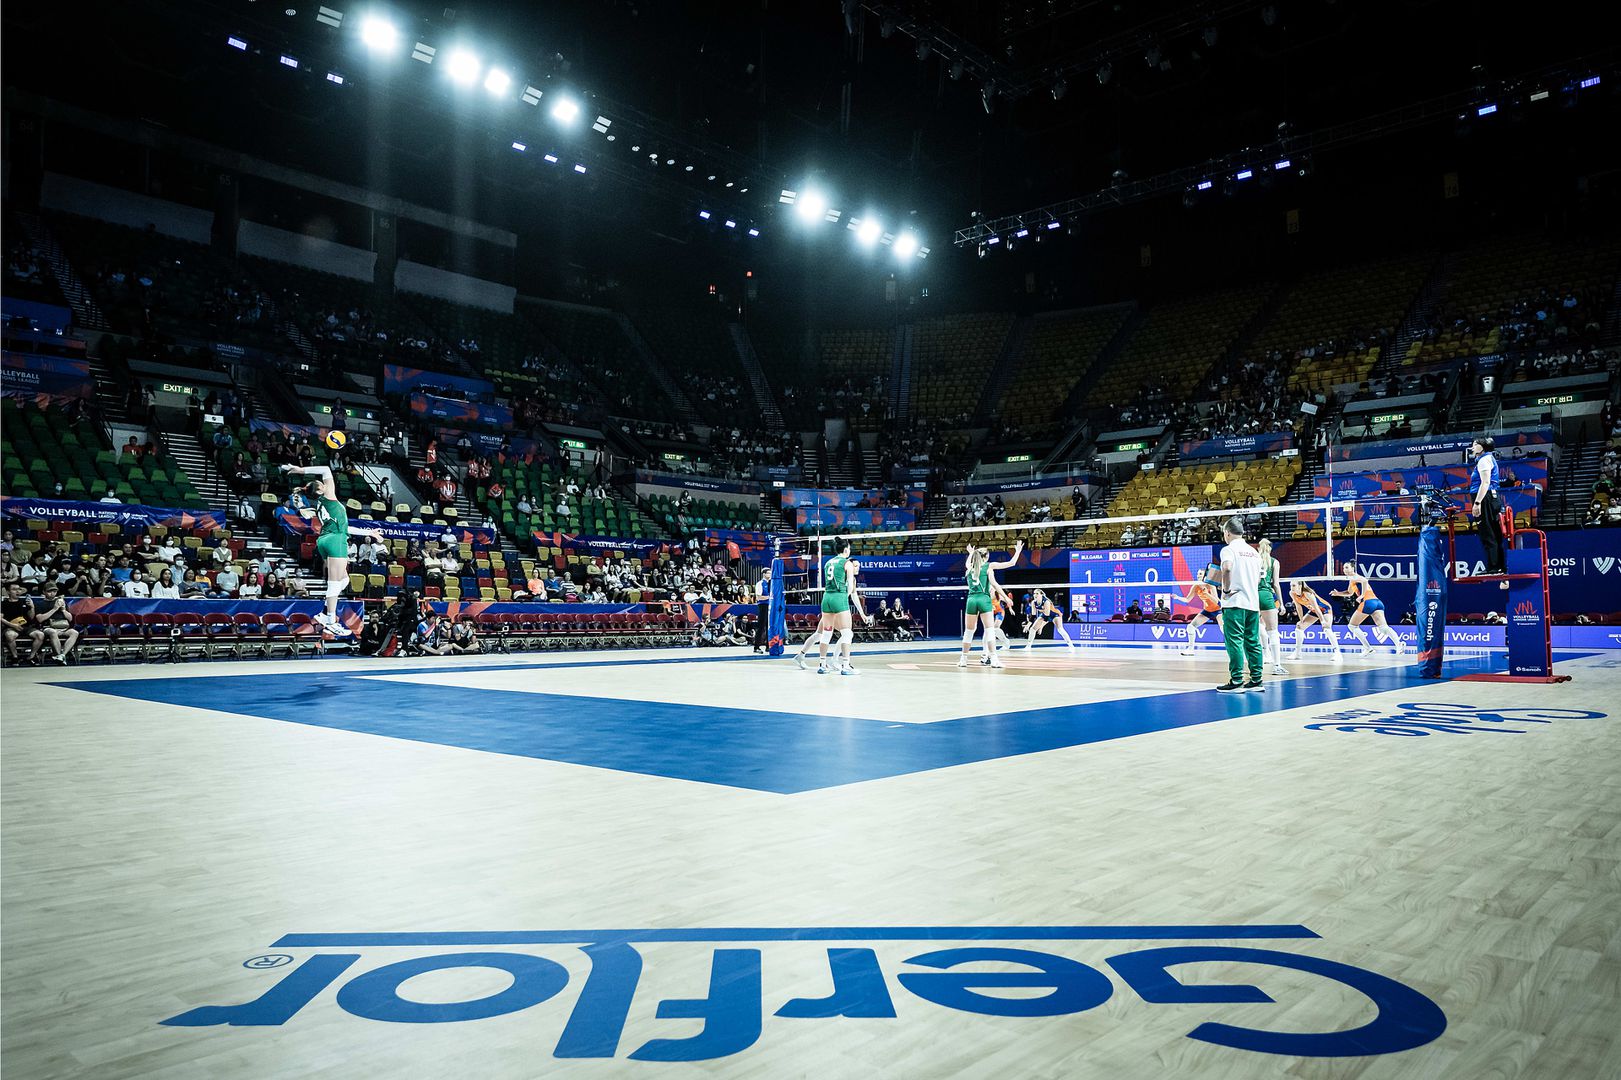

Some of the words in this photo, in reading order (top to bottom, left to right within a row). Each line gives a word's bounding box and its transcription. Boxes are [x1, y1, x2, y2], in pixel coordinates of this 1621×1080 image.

[163, 383, 182, 393] EXIT
[1374, 414, 1391, 423] EXIT
[1406, 444, 1442, 452] VOLLEYBALL
[29, 506, 97, 518] VOLLEYBALL
[360, 527, 406, 536] EYBALL
[858, 561, 897, 569] LLEYBALL
[1547, 557, 1576, 566] IONS
[826, 565, 834, 581] 9
[1085, 569, 1092, 584] 1
[1145, 567, 1159, 583] 0
[1547, 567, 1569, 576] GUE
[1426, 610, 1436, 641] Senoh
[1167, 627, 1207, 639] VBV
[1451, 632, 1490, 642] World
[160, 940, 1447, 1062] Gerflor
